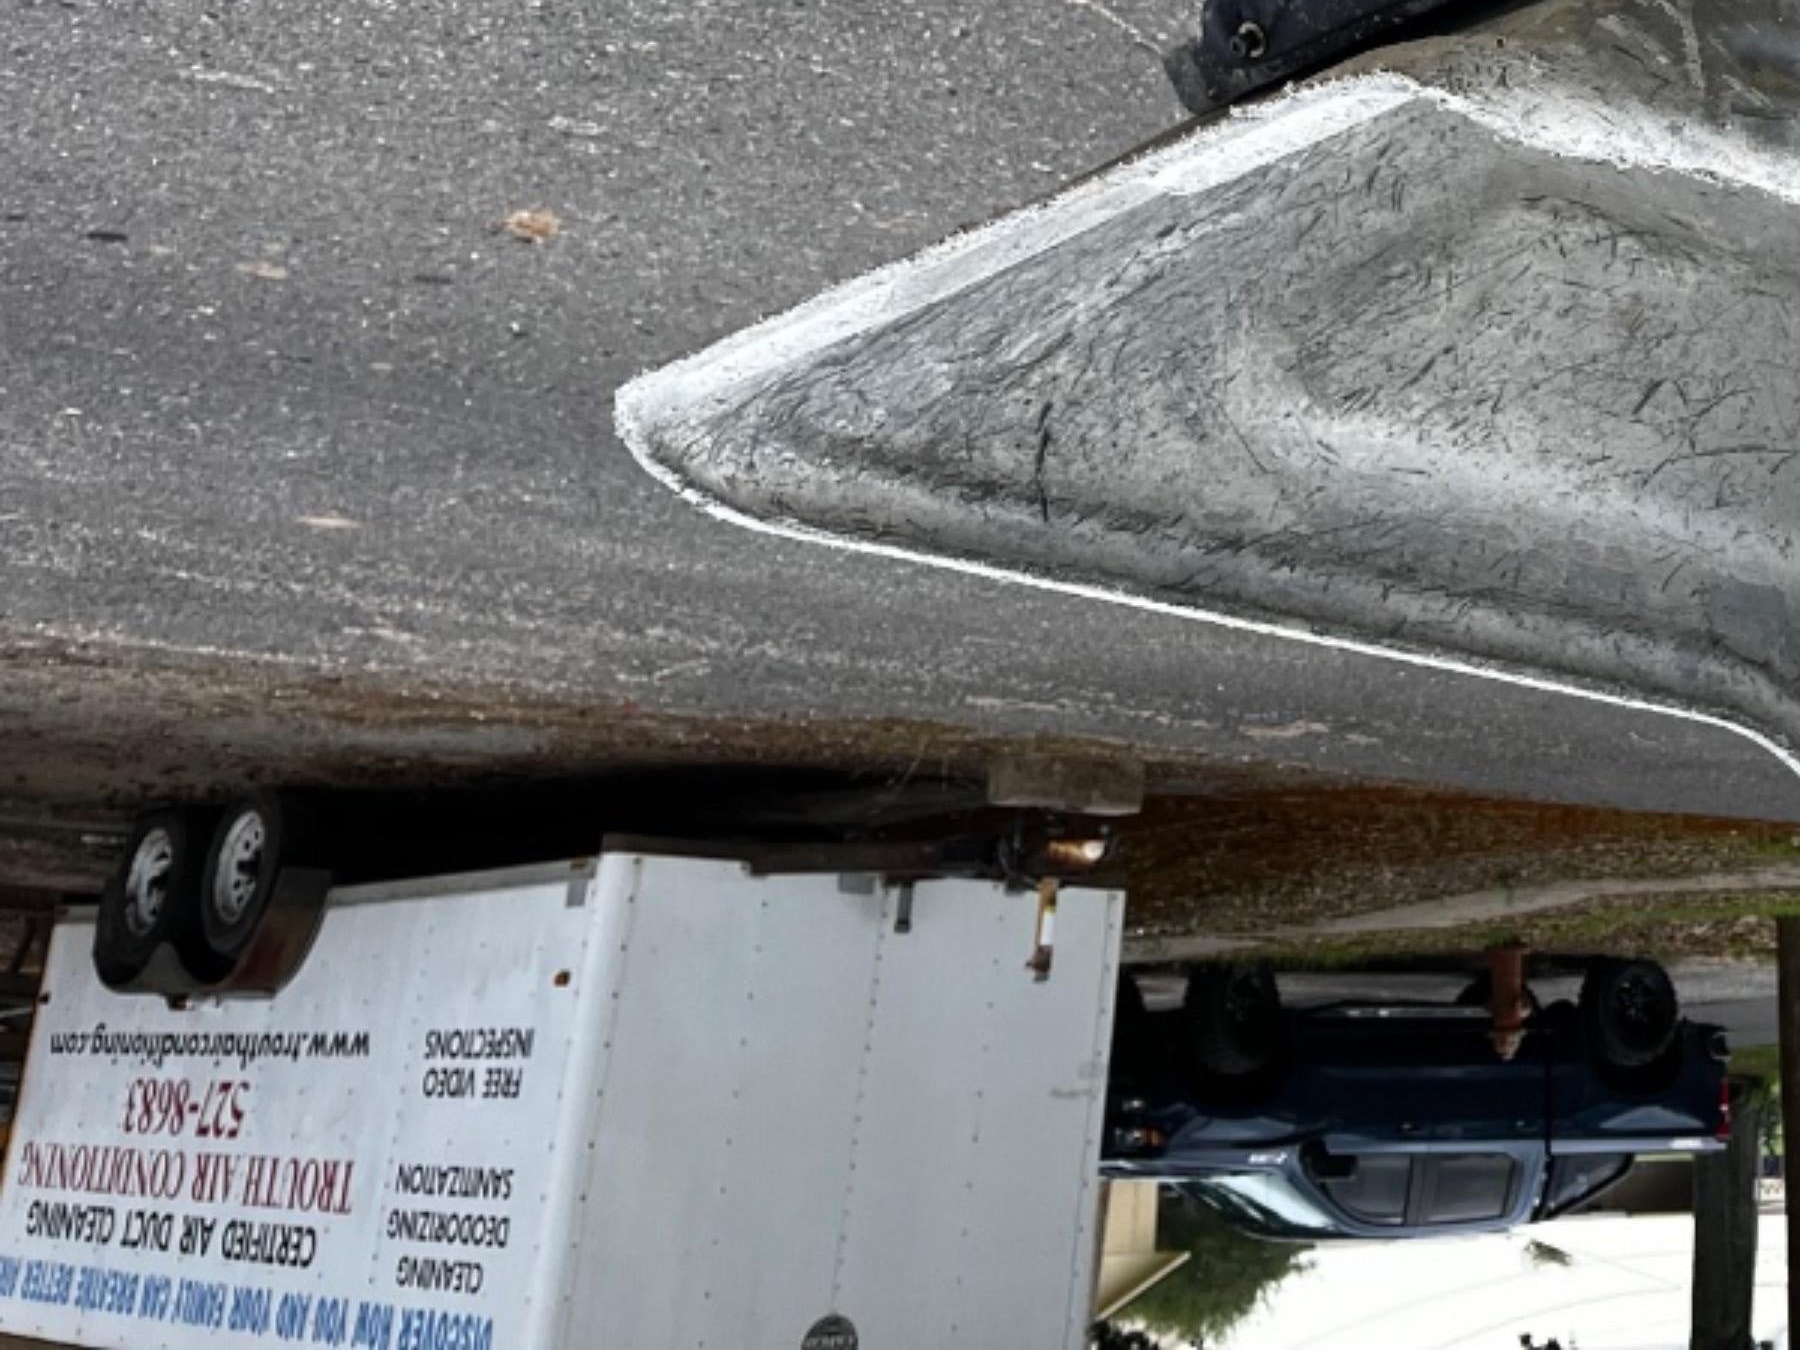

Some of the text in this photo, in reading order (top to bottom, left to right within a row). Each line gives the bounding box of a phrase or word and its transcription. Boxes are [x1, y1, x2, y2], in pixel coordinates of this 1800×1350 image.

[50, 1023, 370, 1071] www.trouthairconditioning.com
[423, 1028, 535, 1059] INSPECTIONS
[422, 1068, 522, 1098] FREE VIDEO
[121, 1079, 250, 1140] 527-8683
[17, 1140, 355, 1215] TROUTH AIR CONDITIONING
[395, 1164, 514, 1201] SANITIZATION
[25, 1200, 316, 1269] CERTIFIED AIR DUCT CLEANING
[387, 1209, 510, 1249] DEODORIZING
[21, 1259, 74, 1307] BETTER
[138, 1274, 171, 1323] CAN
[396, 1256, 484, 1294] CLEANING
[170, 1278, 227, 1330] FAMILY
[229, 1287, 272, 1338] YOUR
[275, 1292, 312, 1342] AND
[312, 1297, 348, 1347] YOU
[350, 1302, 394, 1350] HOW
[398, 1308, 493, 1350] DISCOVER
